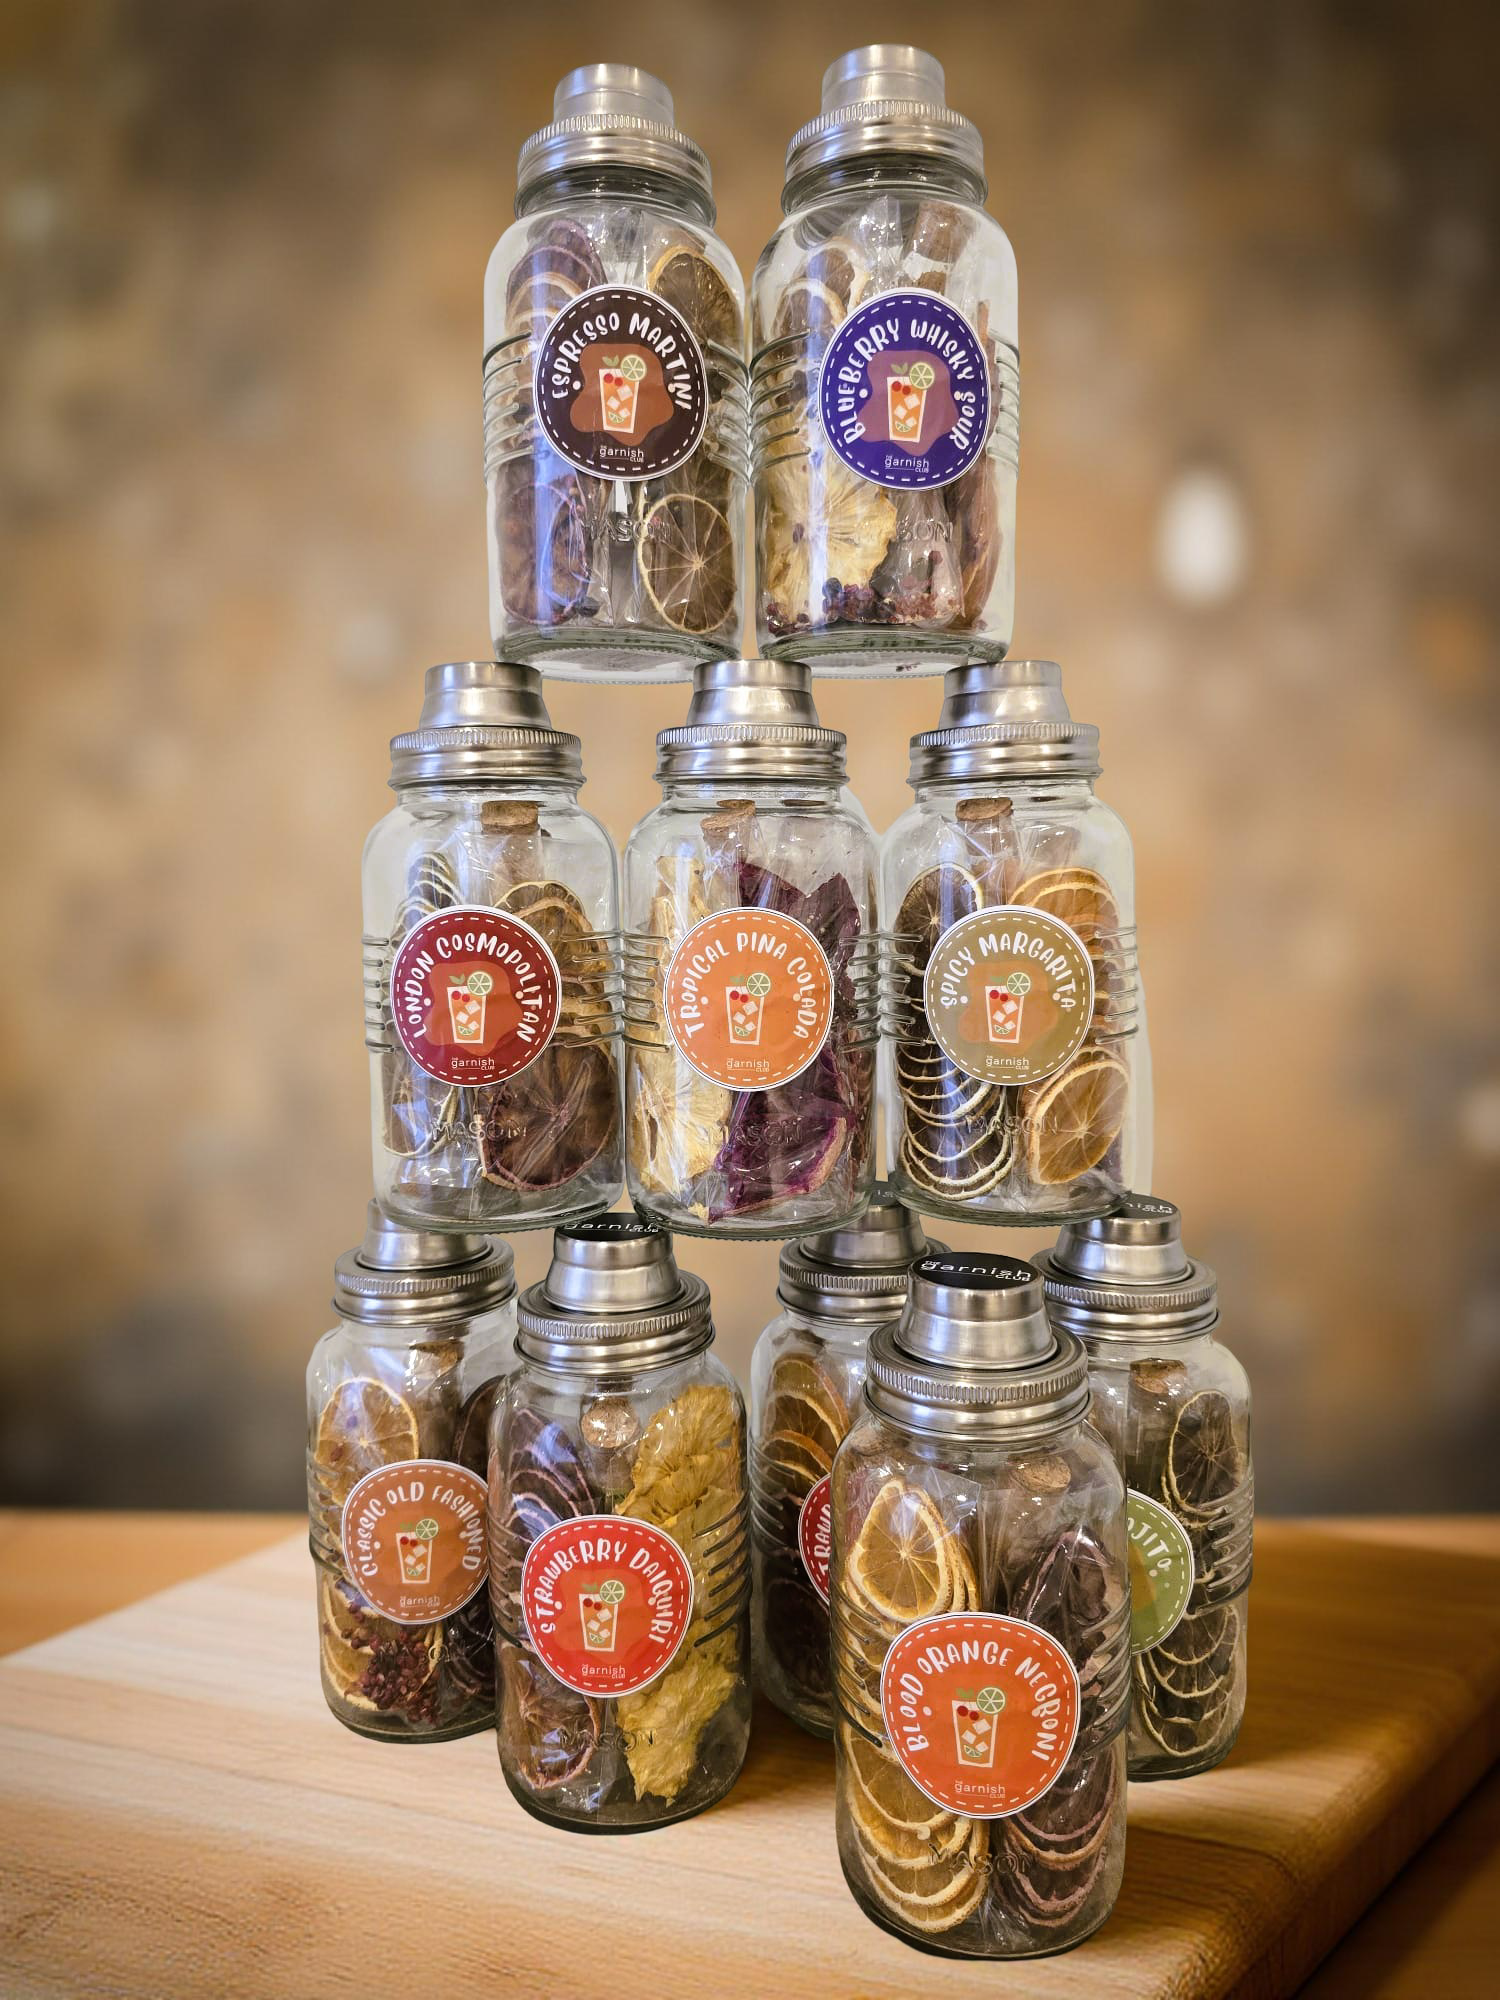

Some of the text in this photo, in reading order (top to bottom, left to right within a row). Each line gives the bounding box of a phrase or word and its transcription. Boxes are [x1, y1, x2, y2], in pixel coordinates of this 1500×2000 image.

[552, 312, 693, 410] ESPRESSO MARTINI
[837, 318, 976, 450] BLUEBERRY WHISKY SOUR
[599, 447, 645, 458] garnish
[884, 457, 930, 468] garnish
[940, 931, 1077, 1008] SPICY MARGARITA
[404, 932, 543, 1043] LONDON COSMOPOLITAN
[680, 939, 729, 1039] TROPICAL
[787, 957, 818, 1039] COLADA
[451, 1058, 495, 1069] garnish
[726, 1059, 770, 1070] garnish
[985, 1057, 1030, 1067] garnish
[920, 1260, 1032, 1279] garnish
[356, 1482, 485, 1577] CLASSIC OLD FASHIONED
[1127, 1517, 1173, 1569] OJITO
[399, 1594, 440, 1608] garnish
[533, 1538, 674, 1644] STRAWBERRY DAIQUIRI
[581, 1664, 626, 1677] garnish
[899, 1640, 1061, 1761] BLOOD ORANGE NEGRONI
[954, 1783, 1006, 1794] garnish
